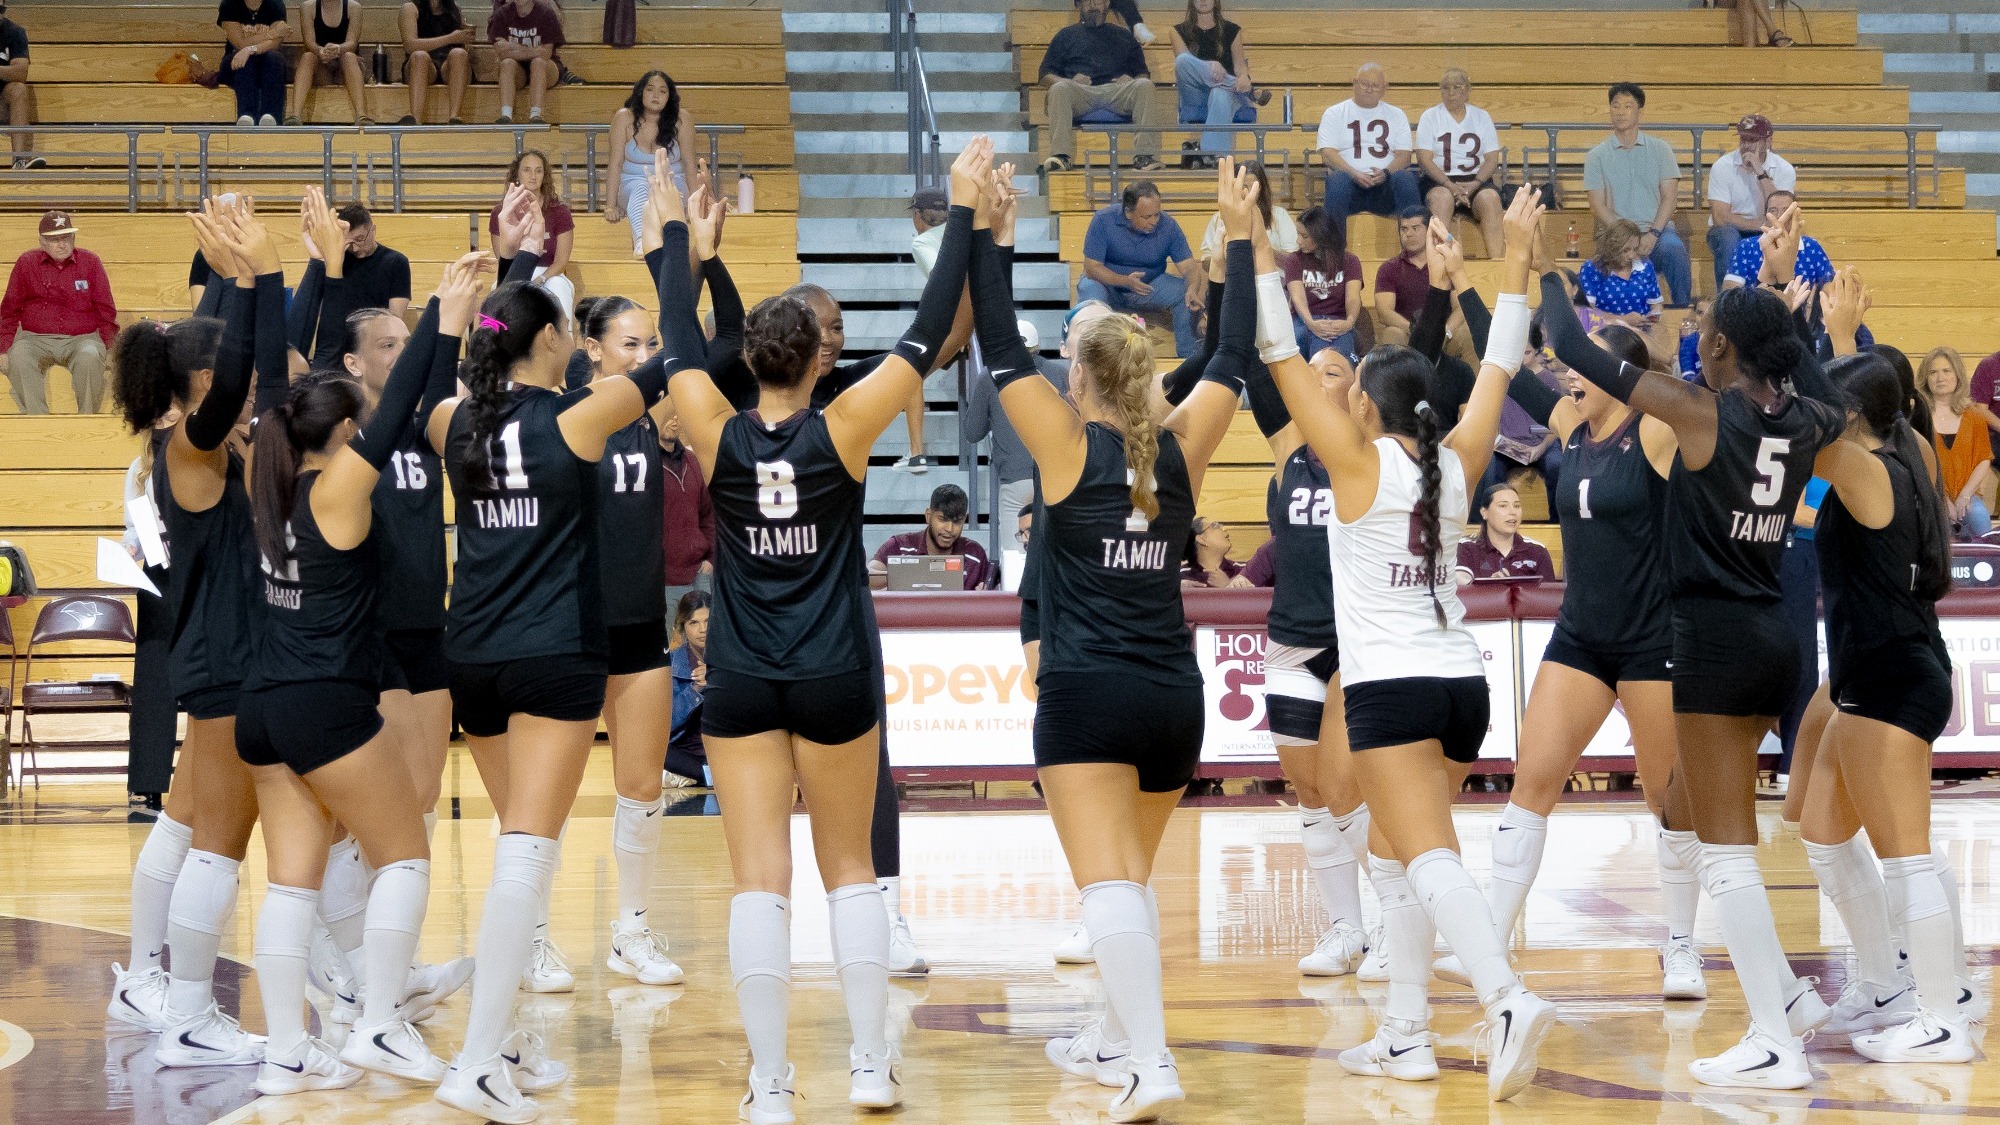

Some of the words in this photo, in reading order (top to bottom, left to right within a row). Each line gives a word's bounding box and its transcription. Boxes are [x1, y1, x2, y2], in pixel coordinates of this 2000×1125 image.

[508, 26, 537, 38] TAMIU
[1347, 119, 1390, 159] 13
[1437, 132, 1481, 173] 13
[391, 450, 427, 490] 16
[612, 452, 648, 492] 17
[755, 459, 798, 519] 8
[1750, 436, 1791, 506] 5
[473, 497, 539, 529] TAMIU
[1288, 487, 1334, 526] 22
[1578, 478, 1592, 519] 1
[745, 524, 818, 555] TAMIU
[1730, 510, 1786, 542] TAMIU
[1102, 538, 1168, 570] TAMIU
[1388, 562, 1448, 588] TAMU
[975, 718, 1034, 731] KITCH
